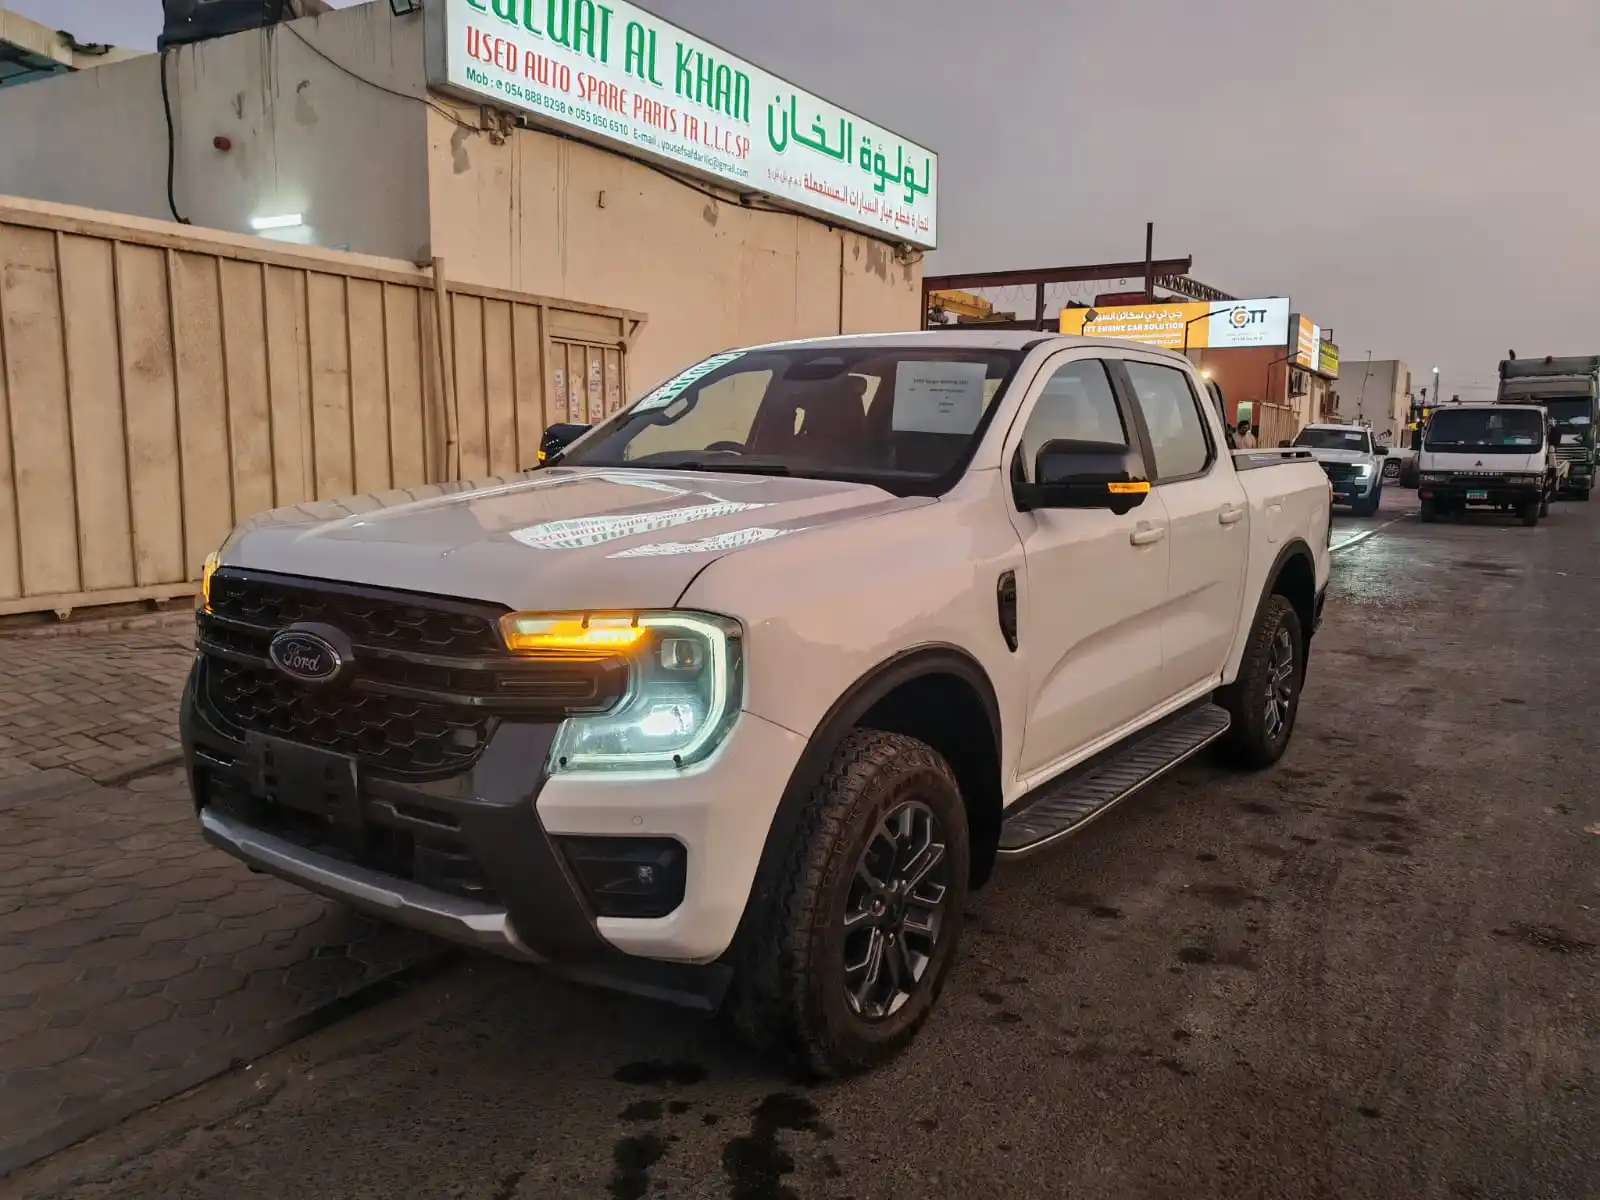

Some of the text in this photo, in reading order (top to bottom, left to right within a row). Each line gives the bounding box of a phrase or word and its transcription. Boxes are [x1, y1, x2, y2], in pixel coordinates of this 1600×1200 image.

[467, 0, 750, 123] LUAT AL KHAN
[467, 25, 518, 73] USED
[524, 50, 570, 93] AUTO
[577, 71, 628, 116] SPARE
[633, 93, 677, 133] PARTS
[682, 112, 698, 142] TR
[504, 82, 523, 98] 054
[525, 89, 542, 105] 888
[544, 95, 566, 114] 8298
[575, 107, 591, 122] 055
[592, 115, 607, 130] 850
[609, 120, 629, 136] 6510
[767, 95, 930, 203] لؤلؤة الخان
[1127, 323, 1143, 331] CAR
[1143, 322, 1184, 331] SOLUTION
[1232, 308, 1267, 325] GTT
[283, 641, 320, 671] Ford
